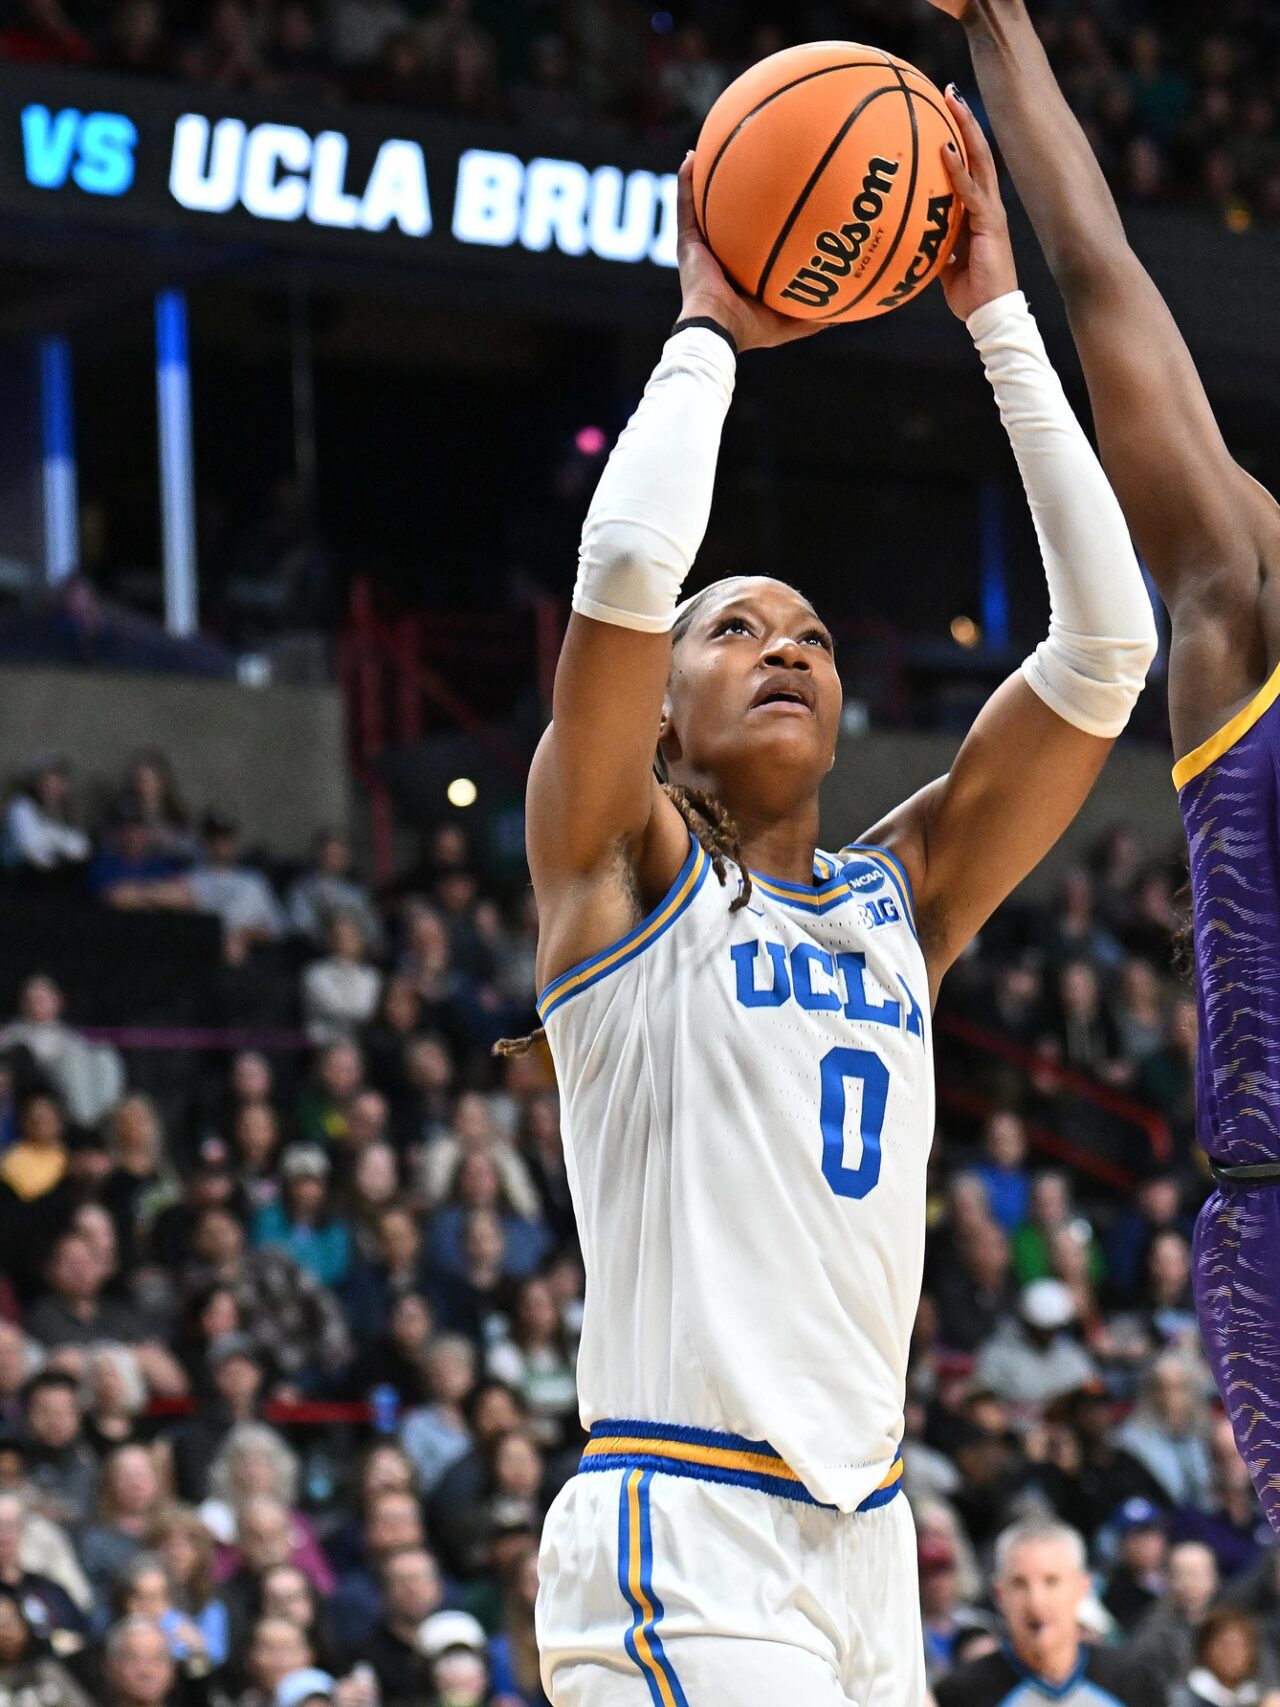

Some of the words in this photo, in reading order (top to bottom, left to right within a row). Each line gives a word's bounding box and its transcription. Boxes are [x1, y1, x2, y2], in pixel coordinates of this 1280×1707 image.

[20, 104, 137, 197] VS
[168, 113, 432, 237] UCLA
[779, 154, 899, 308] Wilson
[876, 193, 954, 307] NCAA
[849, 869, 883, 889] NCAA
[819, 1046, 890, 1200] 0
